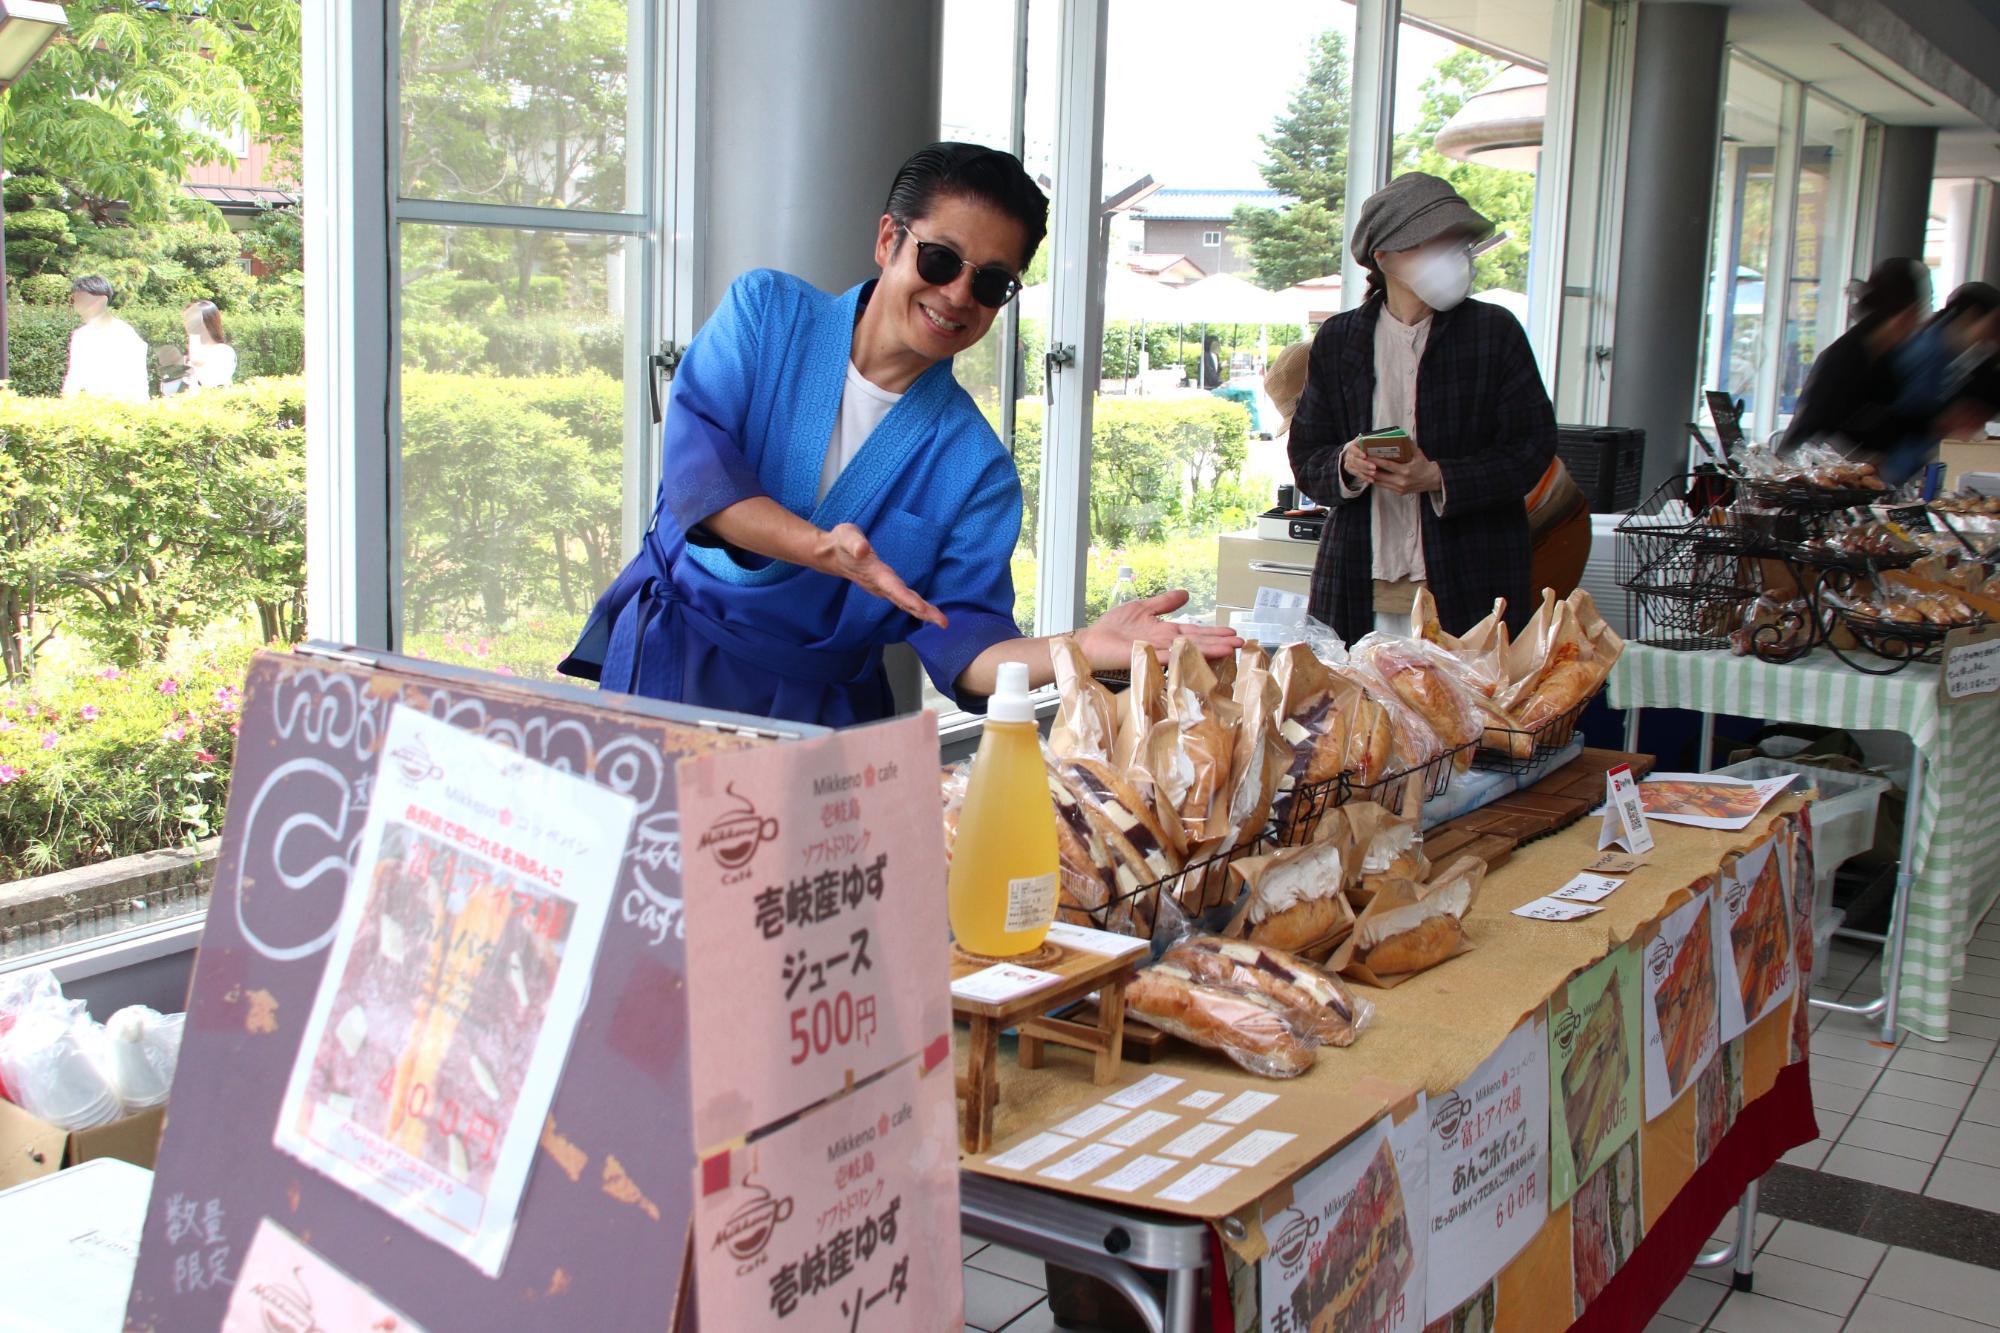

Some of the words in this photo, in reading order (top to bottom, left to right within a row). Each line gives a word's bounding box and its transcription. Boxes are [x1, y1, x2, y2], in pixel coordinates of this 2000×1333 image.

[813, 772, 862, 796] Mikkeno
[878, 760, 898, 783] cafe
[803, 829, 872, 866] ソフトドリンク
[753, 853, 888, 940] 壱岐産ゆず
[782, 927, 873, 1001] ジュース
[790, 990, 877, 1066] 500円
[827, 1126, 876, 1162] Mikkeno
[891, 1102, 913, 1128] cafe
[1460, 1085, 1521, 1149] 富士アイス様
[1452, 1118, 1527, 1195] あんこホイップ
[163, 1193, 226, 1246] 数量
[816, 1178, 885, 1234] ソフトドリンク
[1496, 1172, 1536, 1229] 600円
[171, 1245, 239, 1294] 限定
[769, 1195, 901, 1319] 壱岐産ゆず
[840, 1255, 909, 1333] ソーダ
